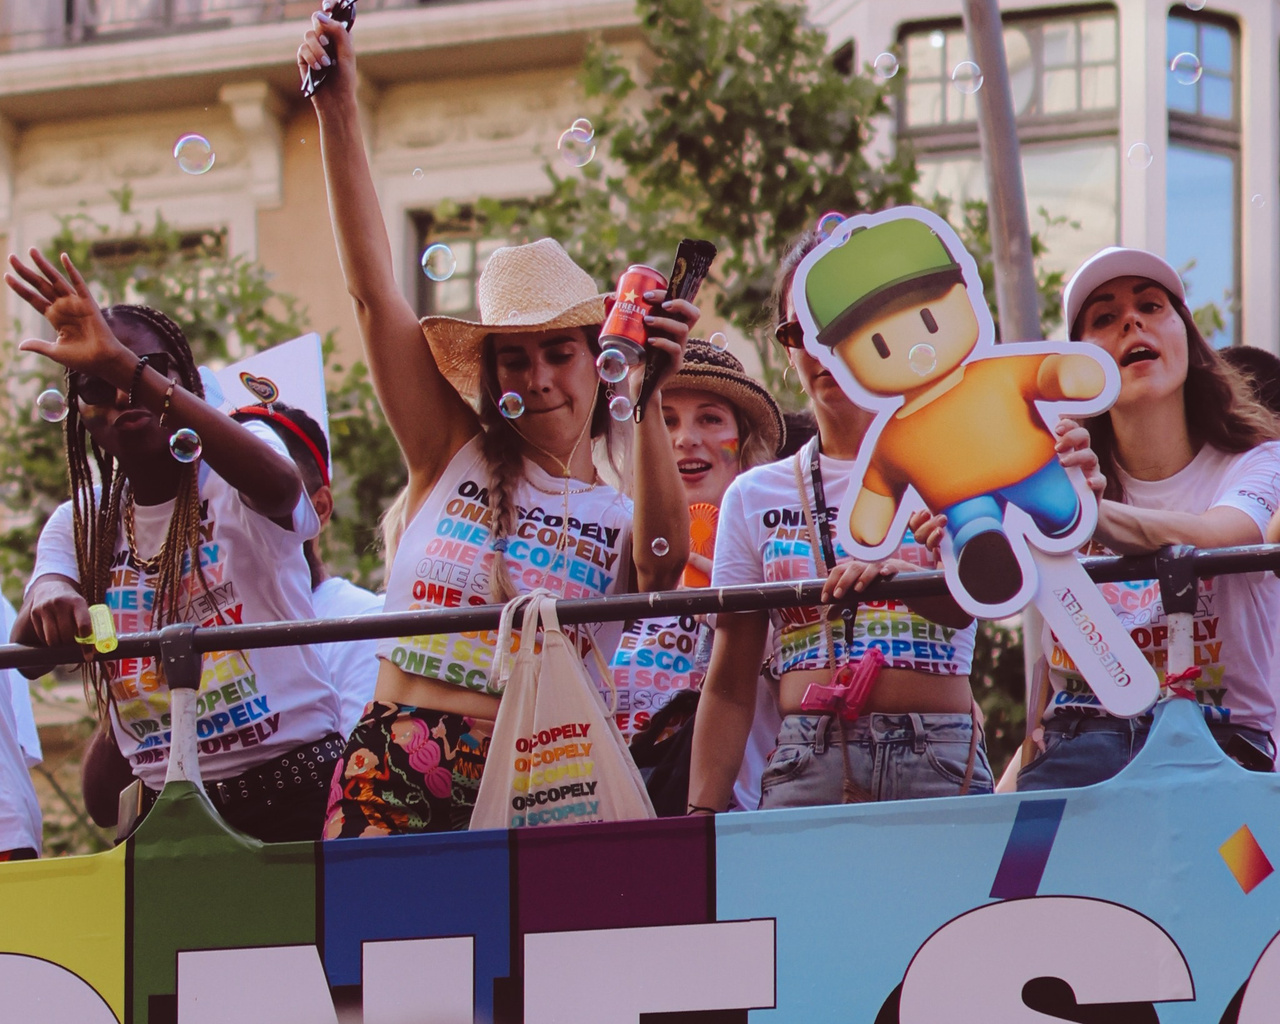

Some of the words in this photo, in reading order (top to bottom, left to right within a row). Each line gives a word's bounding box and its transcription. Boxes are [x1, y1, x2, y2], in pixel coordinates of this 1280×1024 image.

[426, 538, 479, 566] ONE
[436, 518, 489, 547] ONE
[493, 540, 613, 594] COPELY
[517, 522, 618, 572] COPELY
[416, 558, 471, 588] ONE
[412, 580, 462, 608] ONE
[391, 647, 442, 679] ONE
